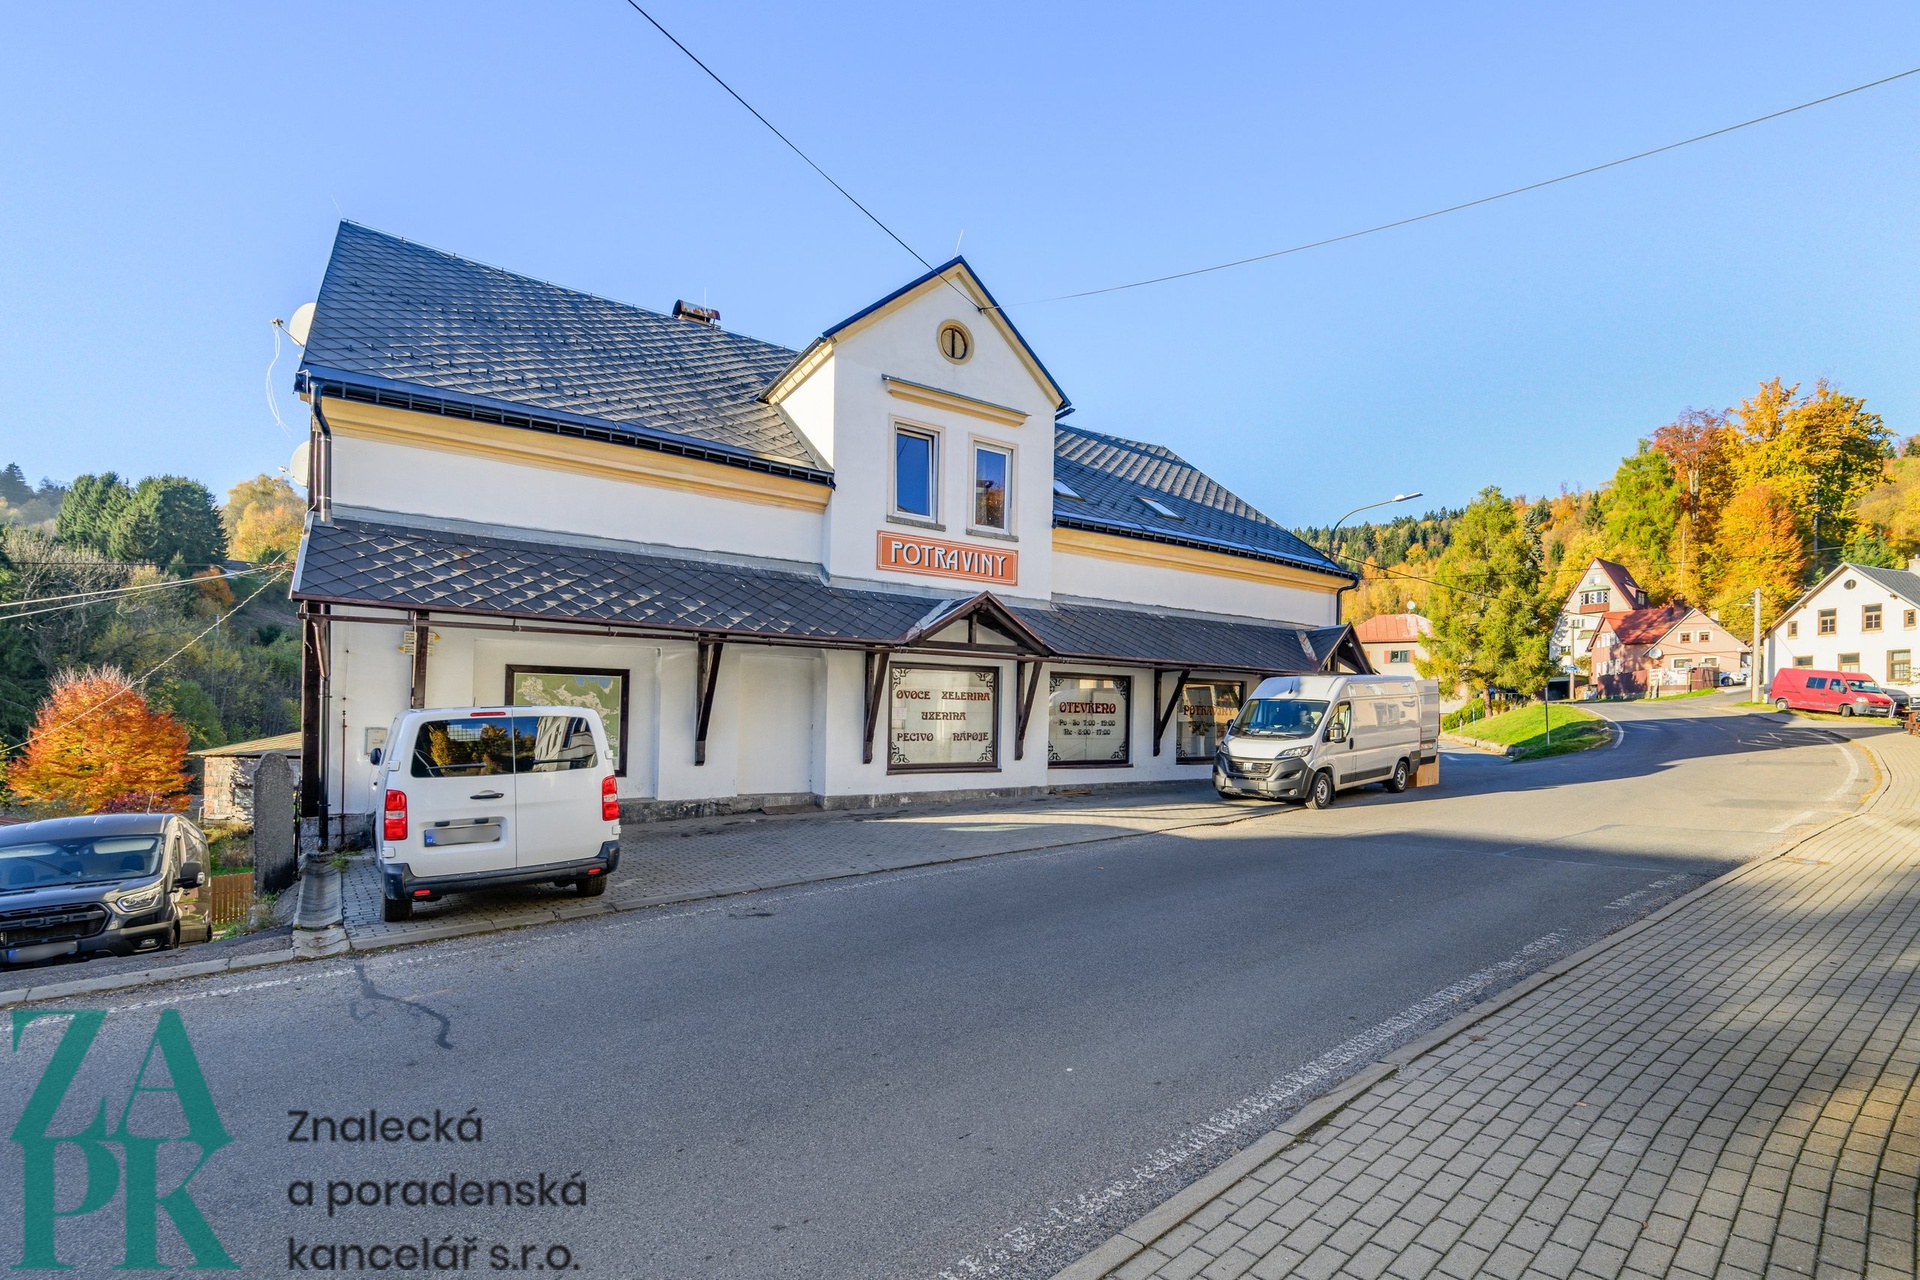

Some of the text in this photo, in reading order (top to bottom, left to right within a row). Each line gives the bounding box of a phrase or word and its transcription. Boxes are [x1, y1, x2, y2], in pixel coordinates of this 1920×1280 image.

[891, 541, 1007, 576] POTRAVINY
[896, 690, 991, 701] OVOCE ZELENINA
[1183, 704, 1233, 716] POTRAVINY
[921, 711, 967, 721] UZENINA
[952, 731, 989, 742] NÁPOJE
